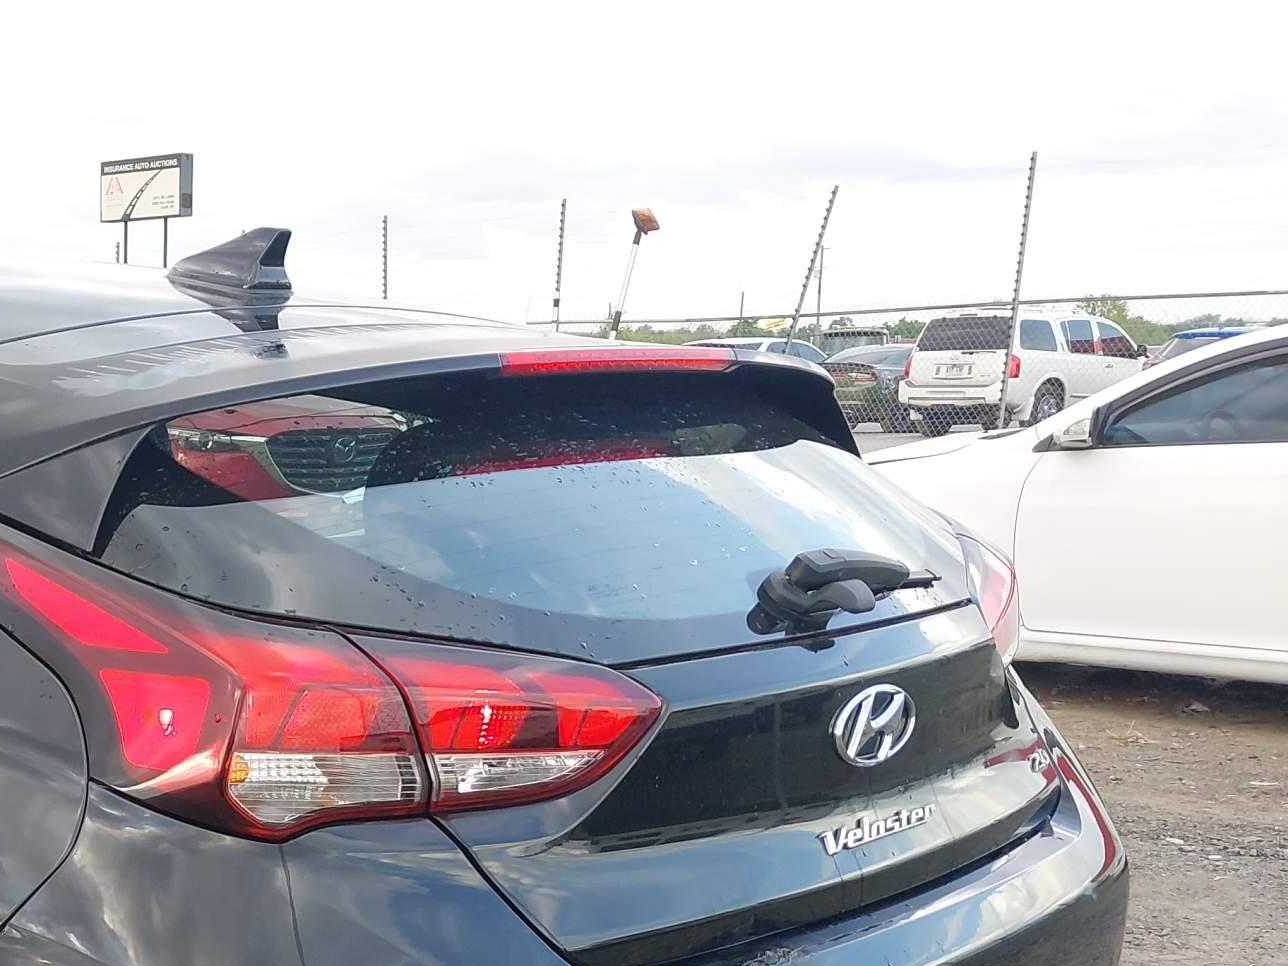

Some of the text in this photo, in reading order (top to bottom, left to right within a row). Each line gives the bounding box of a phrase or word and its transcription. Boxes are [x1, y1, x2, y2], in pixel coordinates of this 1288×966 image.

[104, 164, 134, 173] INSURANCE
[150, 159, 178, 168] AUCTIONS
[818, 804, 936, 855] Veloster
